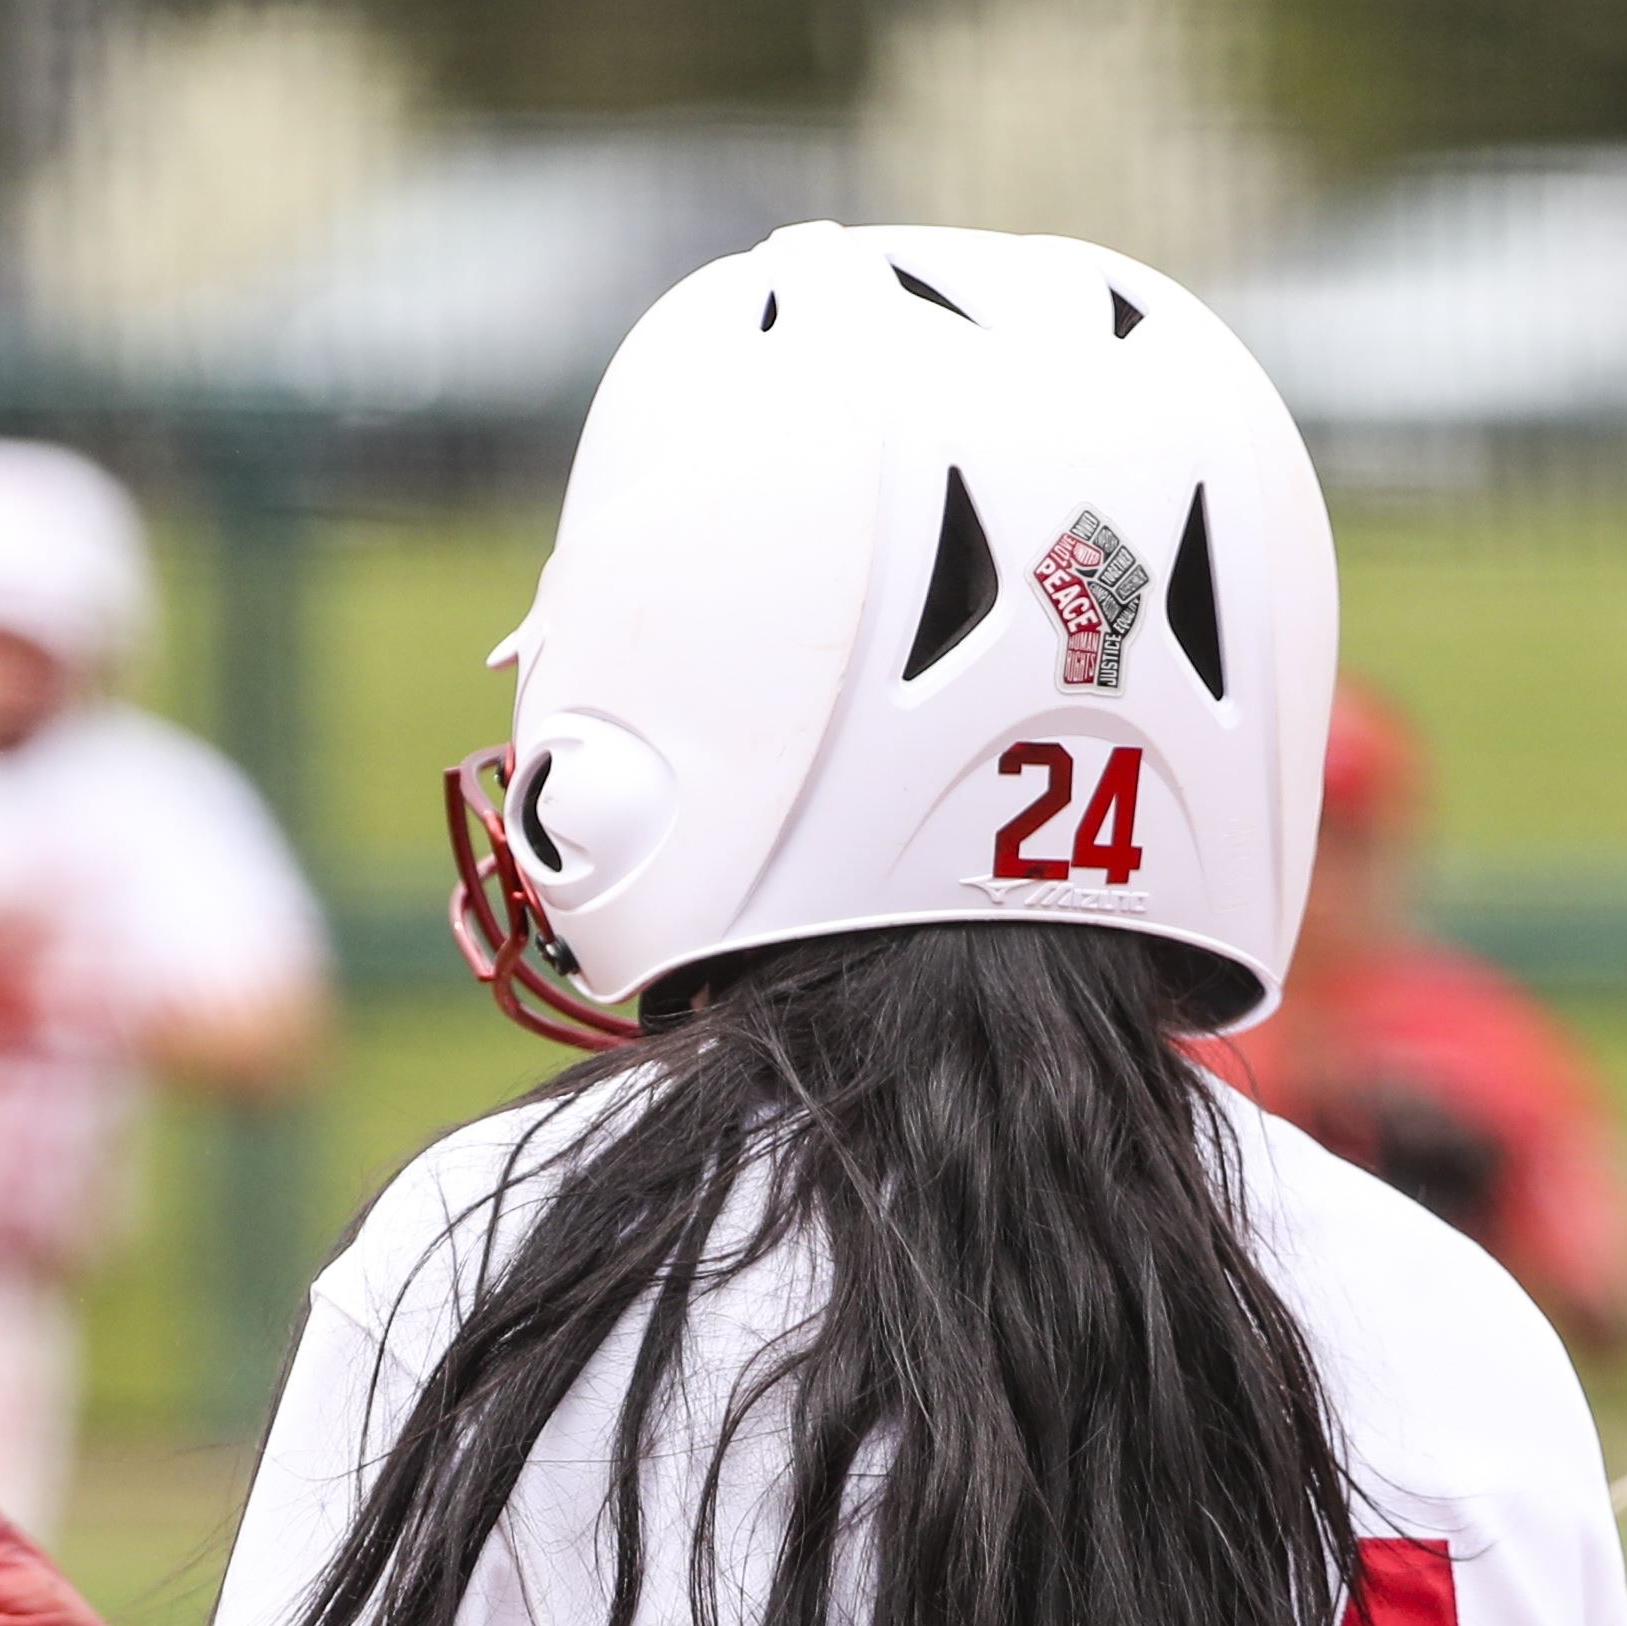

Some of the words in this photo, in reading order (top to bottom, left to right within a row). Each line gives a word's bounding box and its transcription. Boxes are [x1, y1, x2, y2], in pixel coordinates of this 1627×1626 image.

[1050, 534, 1076, 567] LOVE
[1035, 557, 1099, 633] PEACE
[1113, 597, 1140, 634] EQUALITY
[1068, 631, 1101, 652] HUMAN
[1099, 633, 1121, 686] JUSTICE
[993, 742, 1143, 884] 24
